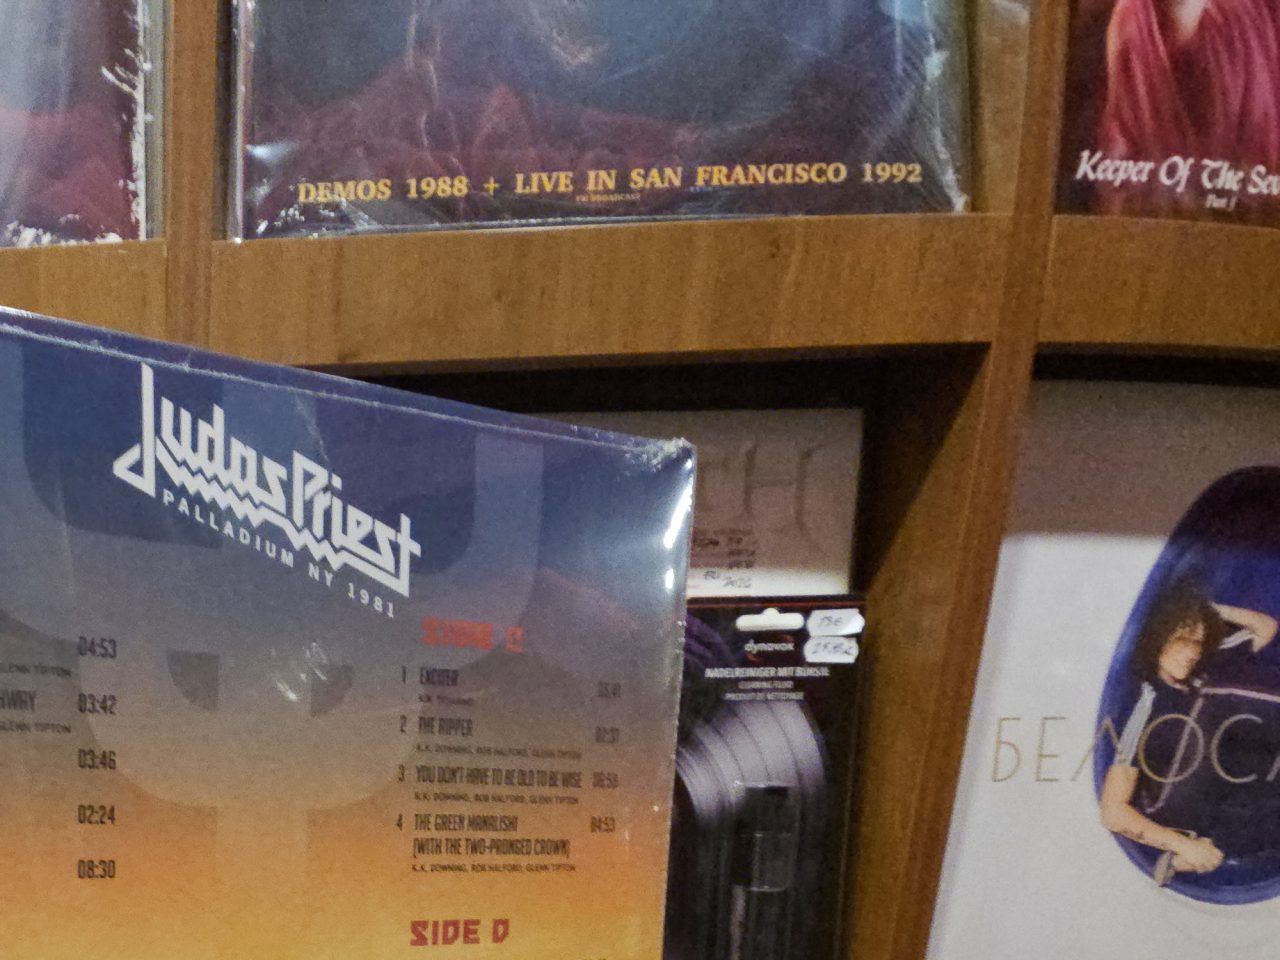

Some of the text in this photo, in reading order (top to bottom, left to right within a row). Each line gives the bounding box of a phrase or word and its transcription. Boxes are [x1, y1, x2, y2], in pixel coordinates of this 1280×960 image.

[298, 177, 392, 203] DEMOS
[406, 175, 469, 199] 1988
[515, 170, 573, 194] LIVE
[586, 168, 617, 191] IN
[629, 166, 683, 189] SAN
[695, 162, 848, 187] FRANCISCO
[861, 162, 922, 184] 1992
[1075, 149, 1154, 187] Keeper
[1158, 155, 1195, 193] Of
[1201, 158, 1244, 192] The
[113, 361, 422, 598] Judas Priest
[163, 488, 395, 619] PALLADIUM NY 1981
[78, 635, 117, 660] 04:53
[78, 692, 117, 716] 03:42
[78, 748, 117, 771] 03:46
[415, 764, 436, 784] YOU
[77, 805, 117, 826] 02:24
[414, 813, 431, 832] THE
[434, 814, 465, 832] GREEN
[445, 838, 462, 855] THE
[77, 859, 117, 880] 08:30
[410, 918, 510, 946] SIDE D
